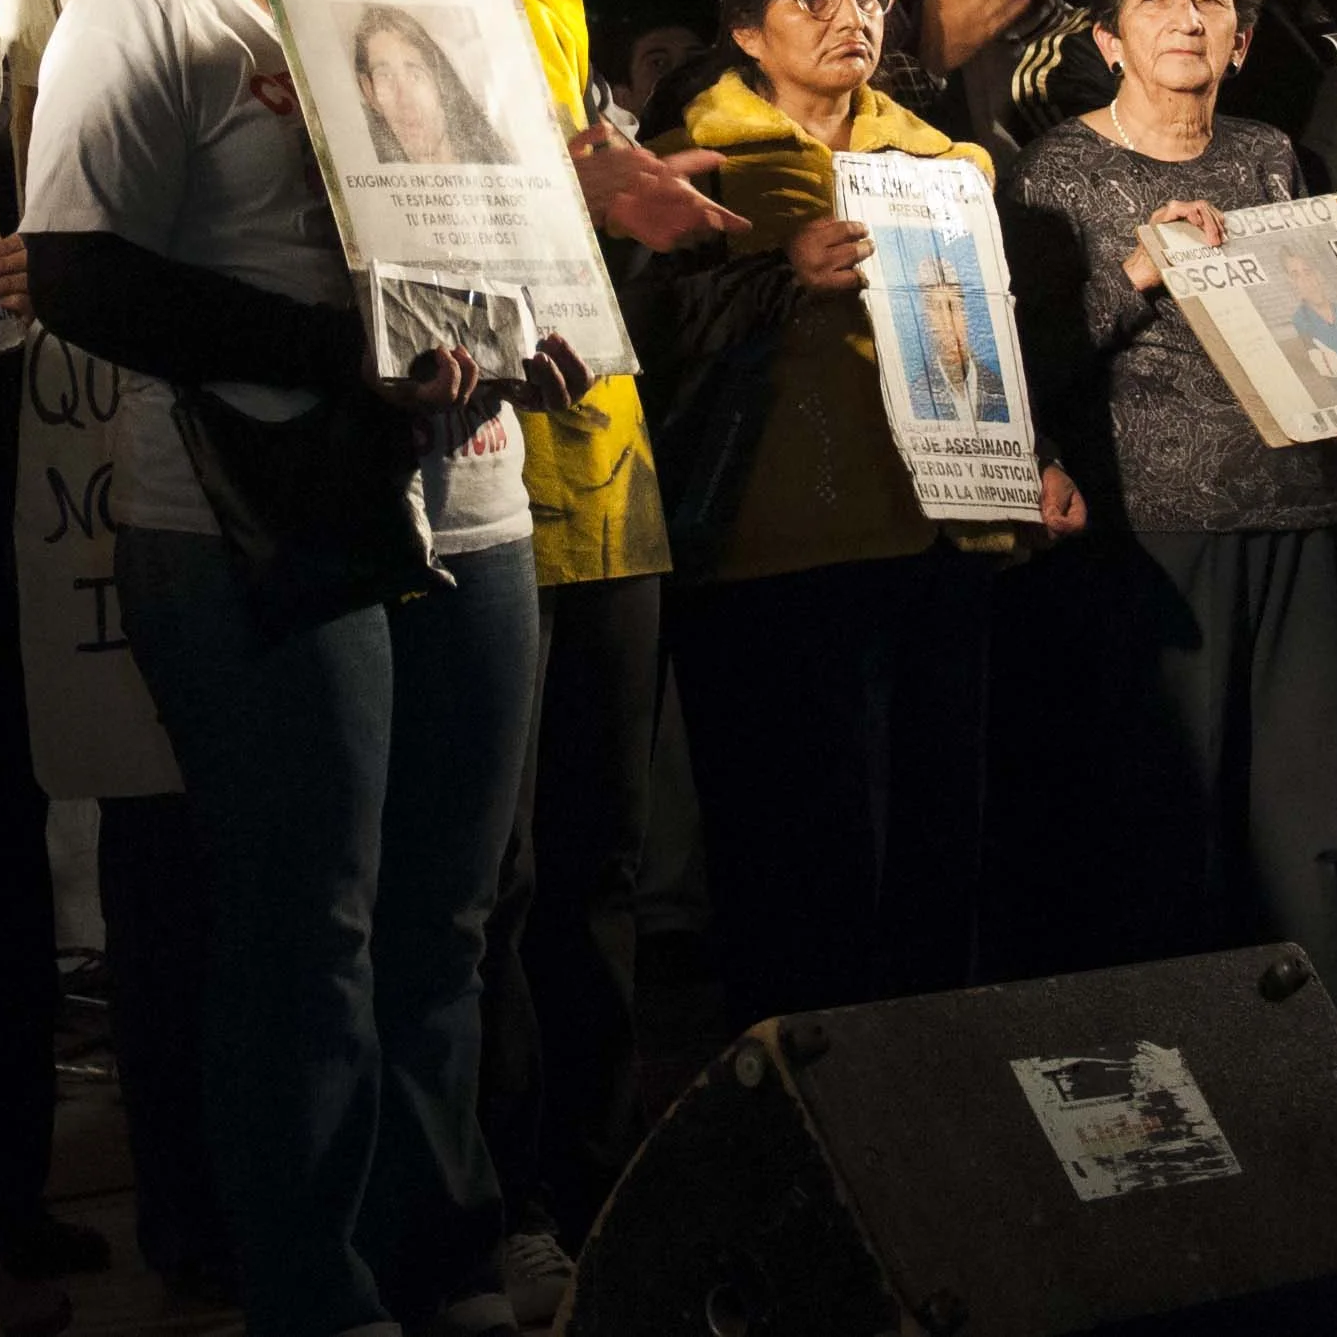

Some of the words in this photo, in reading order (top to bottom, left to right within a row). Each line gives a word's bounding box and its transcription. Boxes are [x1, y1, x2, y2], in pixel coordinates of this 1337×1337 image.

[1225, 195, 1333, 238] OBERTO
[1167, 258, 1266, 297] OSCAR
[967, 463, 975, 477] Y
[979, 463, 1035, 482] JUSTICIA
[944, 484, 954, 500] A
[954, 485, 974, 501] LA
